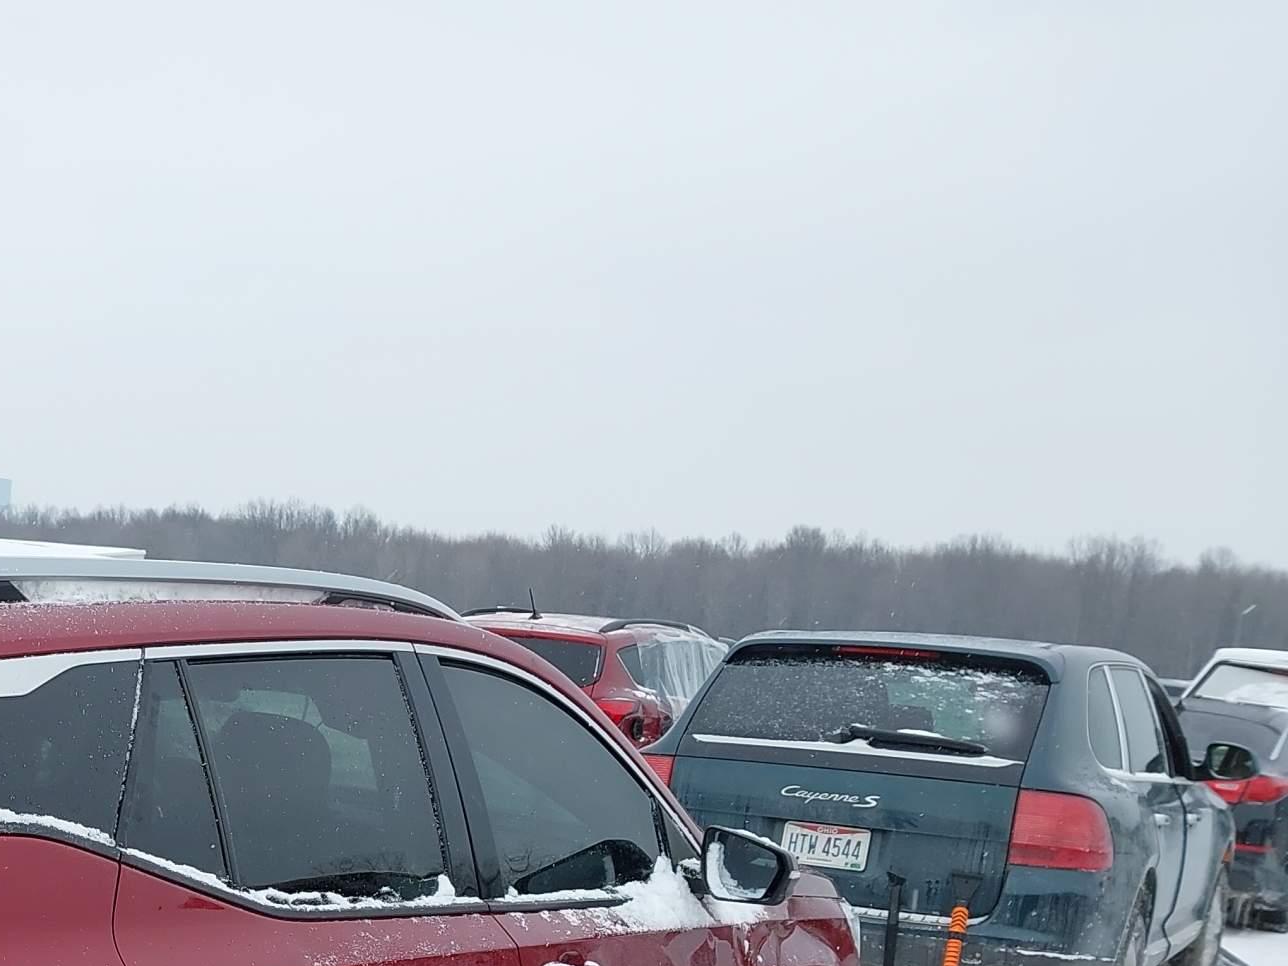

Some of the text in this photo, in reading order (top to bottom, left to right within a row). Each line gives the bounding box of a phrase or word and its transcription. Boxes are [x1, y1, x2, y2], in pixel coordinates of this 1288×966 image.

[781, 785, 881, 808] Cayenne S
[817, 826, 839, 834] OHIO
[822, 836, 862, 860] 4544
